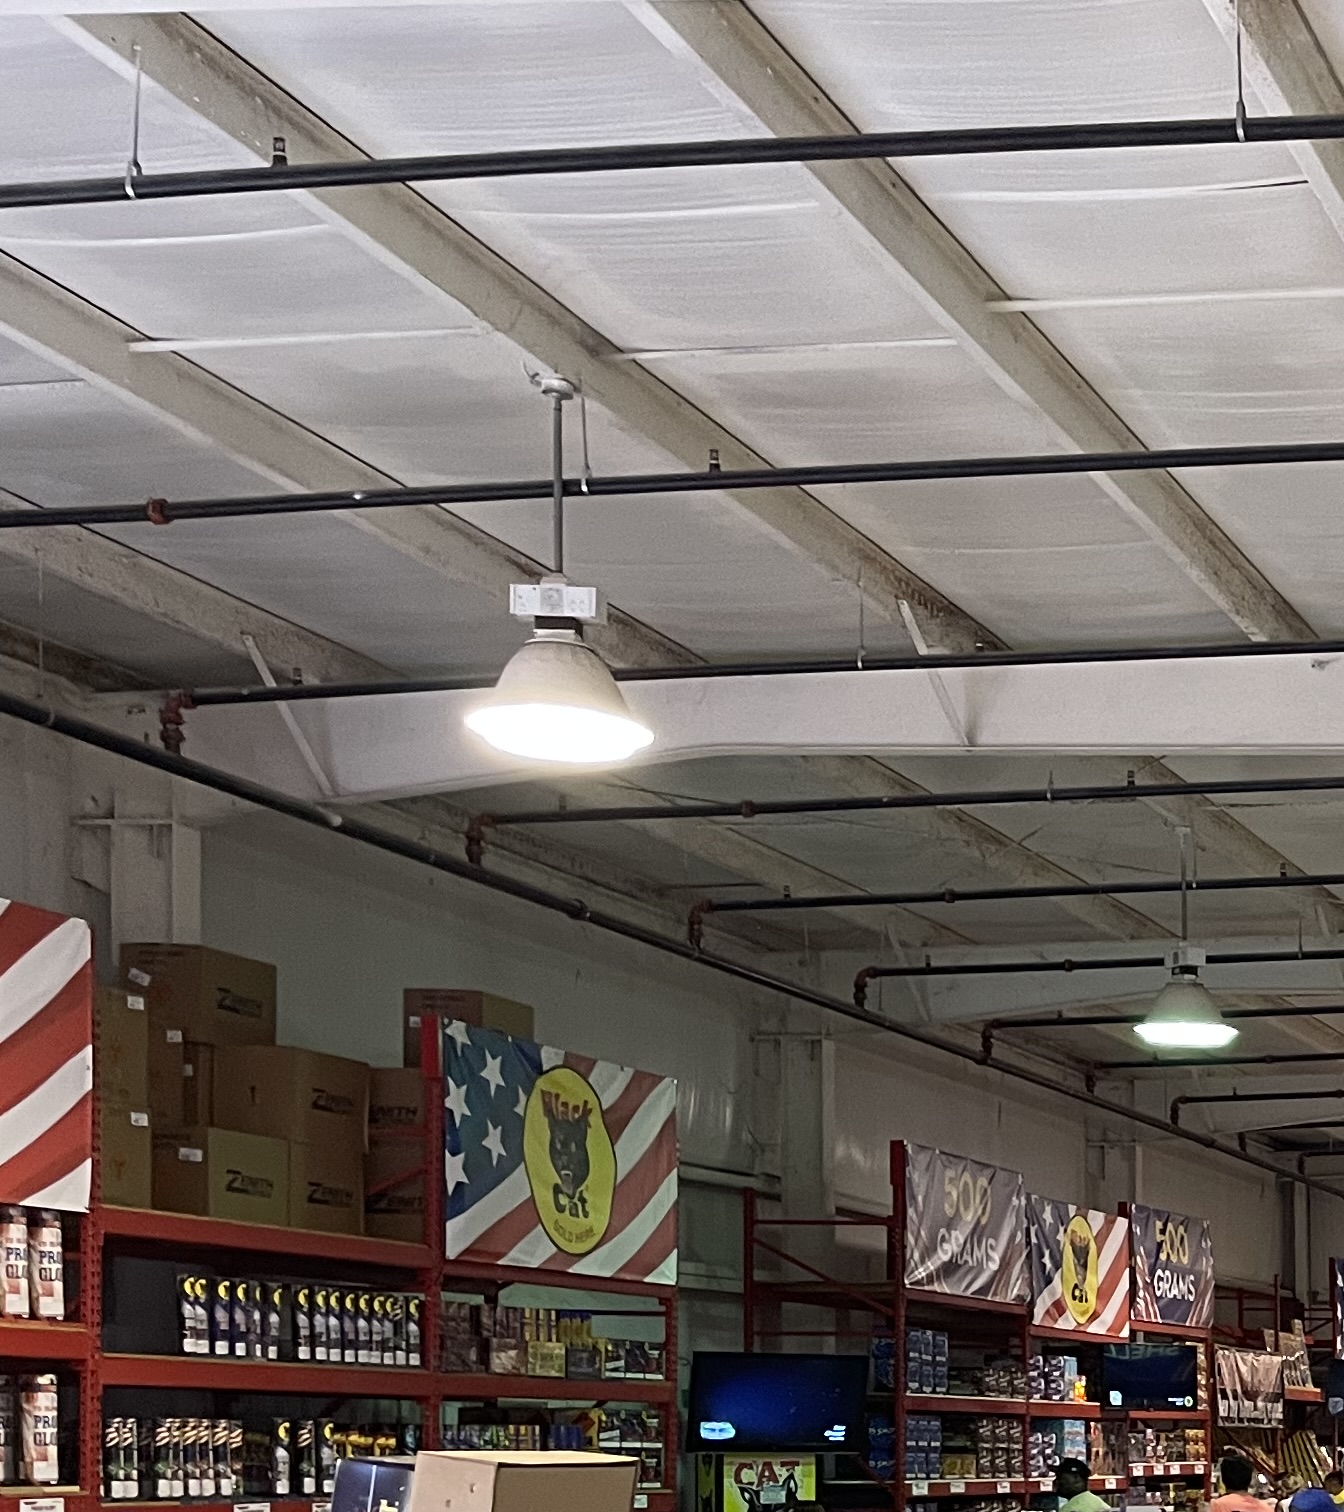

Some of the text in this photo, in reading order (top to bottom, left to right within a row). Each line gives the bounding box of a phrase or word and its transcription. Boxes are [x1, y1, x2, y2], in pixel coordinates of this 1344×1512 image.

[553, 1183, 590, 1219] Cat
[944, 1169, 992, 1226] 500
[936, 1228, 1000, 1272] GRAMS
[1154, 1220, 1190, 1266] 500
[1153, 1268, 1196, 1302] GRAMS
